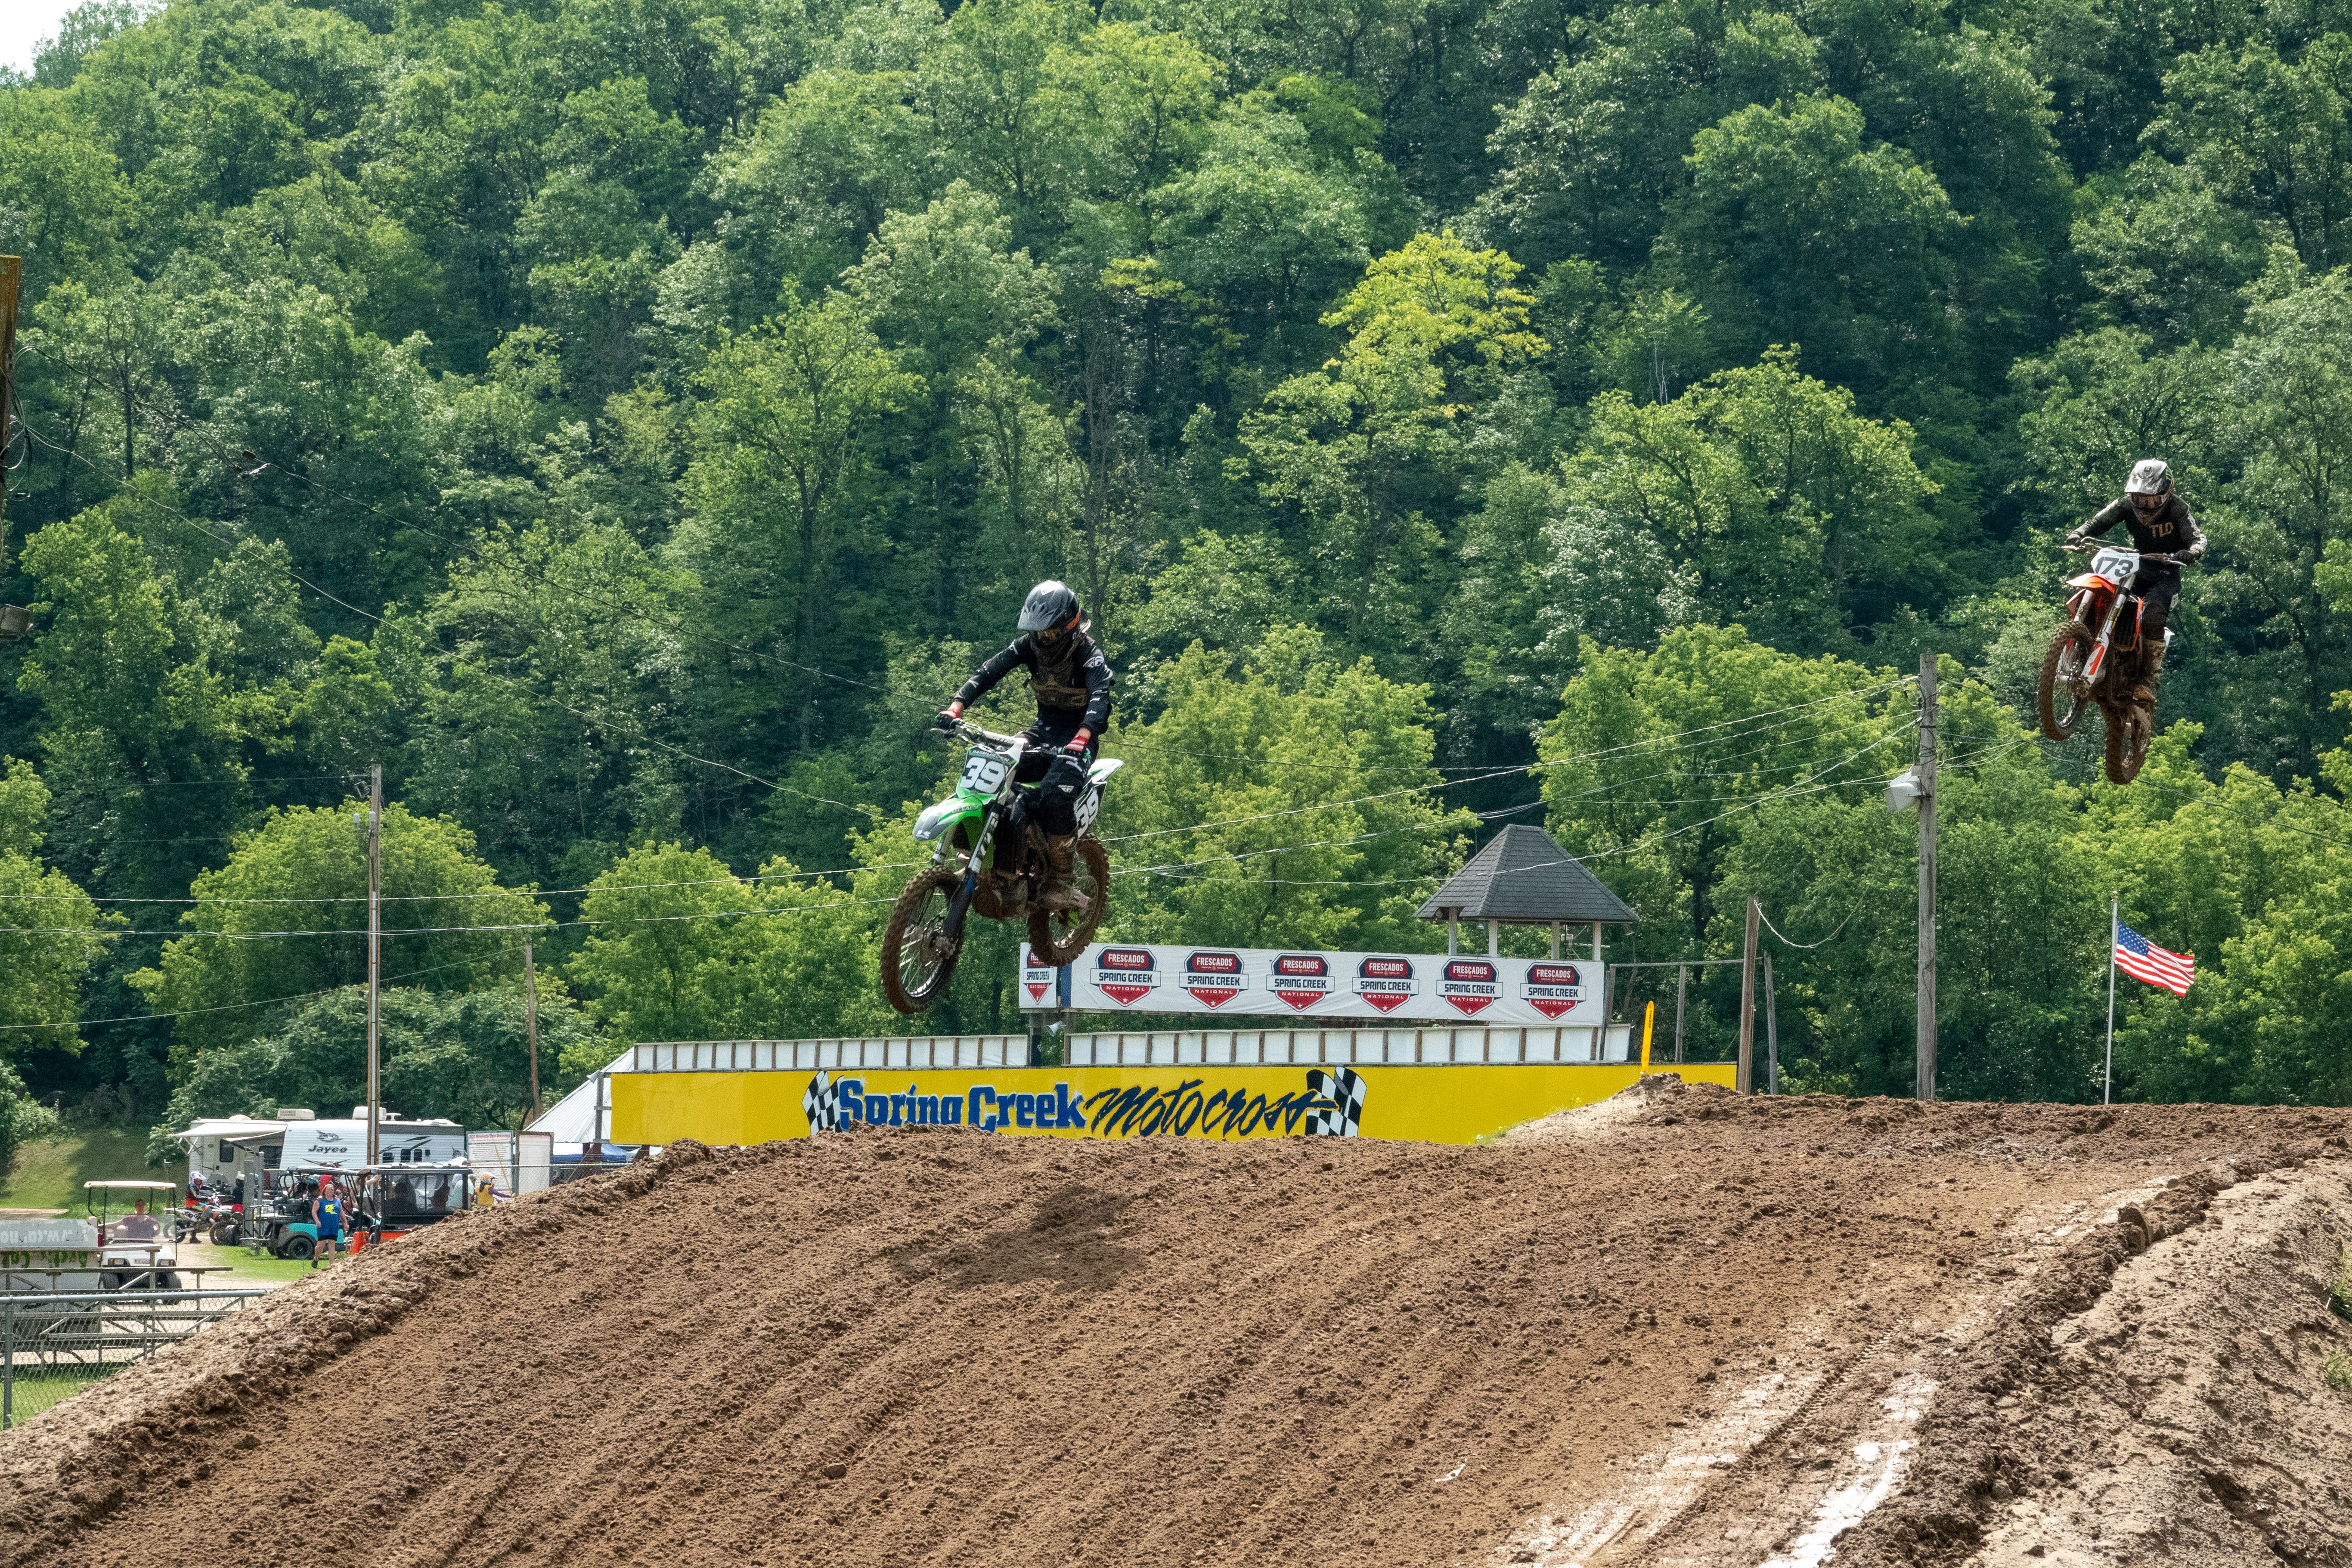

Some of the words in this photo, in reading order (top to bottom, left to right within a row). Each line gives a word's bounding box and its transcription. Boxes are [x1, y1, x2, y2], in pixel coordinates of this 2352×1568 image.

[2149, 522, 2173, 538] TLD
[2095, 556, 2133, 577] 173
[960, 757, 1008, 793] 39
[1076, 788, 1099, 838] 39
[1108, 954, 1144, 963] FRESCADOS
[1197, 957, 1232, 966] FRESCADOS
[1283, 960, 1318, 969] FRESCADOS
[1369, 963, 1404, 971] FRESCADOS
[1027, 971, 1039, 980] SPRING
[1040, 971, 1049, 980] CREEK
[1453, 966, 1487, 975] FRESCADOS
[1537, 969, 1571, 978] FRESCADOS
[1099, 972, 1126, 982] SPRING
[1128, 973, 1153, 983] CREEK
[1187, 976, 1214, 985] SPRING
[1216, 977, 1240, 986] CREEK
[1275, 979, 1301, 988] SPRING
[1303, 979, 1326, 988] CREEK
[1360, 981, 1386, 990] SPRING
[1388, 982, 1411, 991] CREEK
[1444, 984, 1470, 993] SPRING
[1472, 985, 1495, 994] CREEK
[1528, 987, 1554, 996] SPRING
[1556, 988, 1578, 997] CREEK
[840, 1078, 964, 1132] Spring
[968, 1082, 1087, 1132] Creek
[1083, 1079, 1338, 1137] Motocross
[308, 1145, 347, 1153] Jayco
